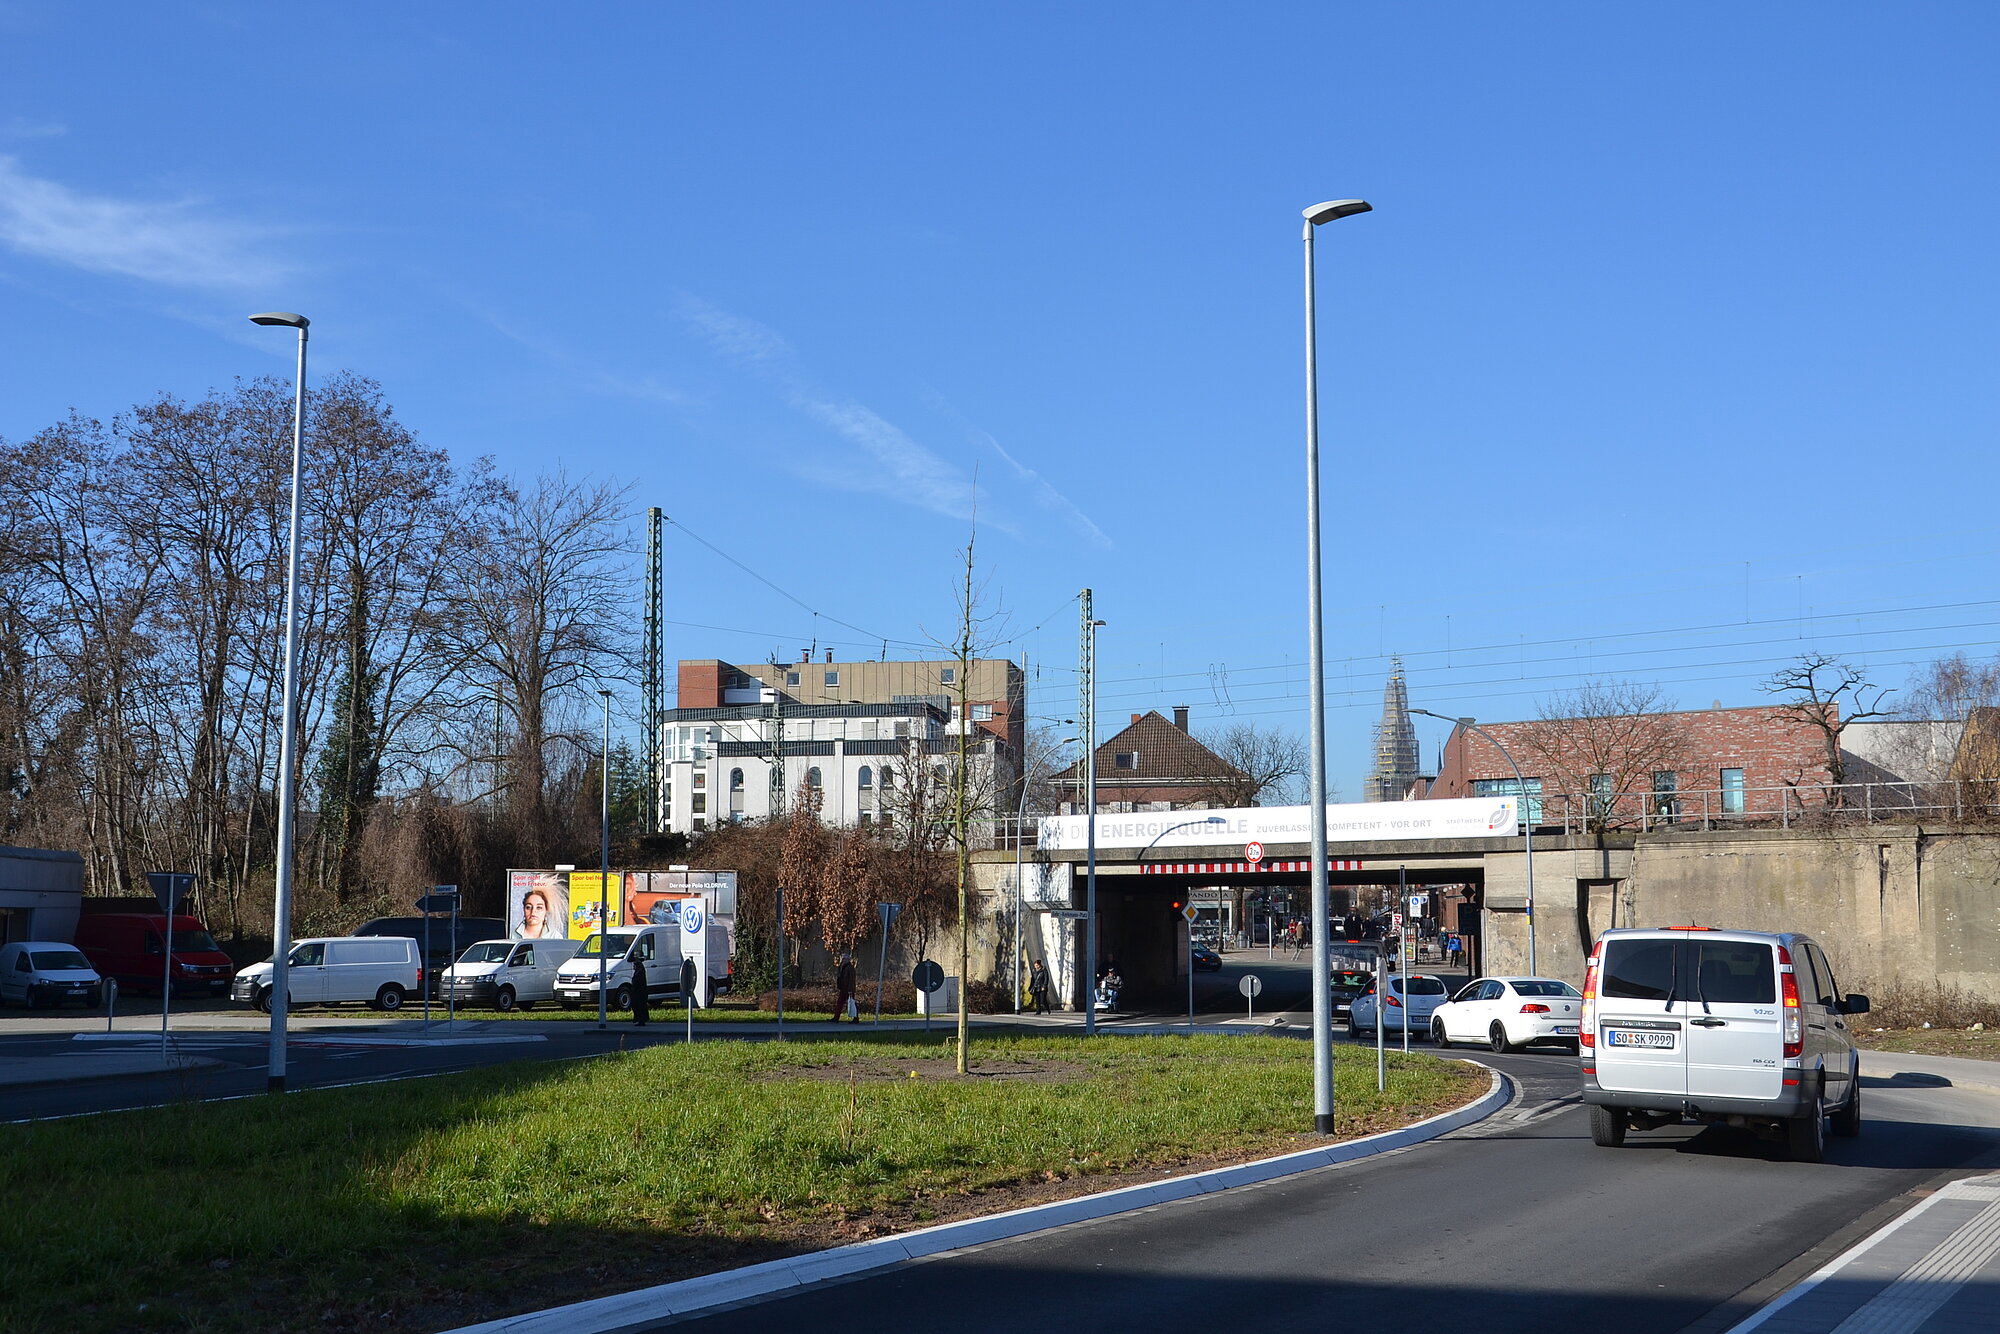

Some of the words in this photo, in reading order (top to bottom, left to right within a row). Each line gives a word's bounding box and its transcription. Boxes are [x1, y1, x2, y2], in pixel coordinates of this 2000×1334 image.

[1101, 819, 1248, 838] ENERGIEQUELLE
[1390, 820, 1410, 828] VOR
[1412, 819, 1432, 828] ORT
[1616, 1033, 1628, 1044] SO
[1634, 1034, 1646, 1044] SK
[1648, 1035, 1672, 1045] 9999
